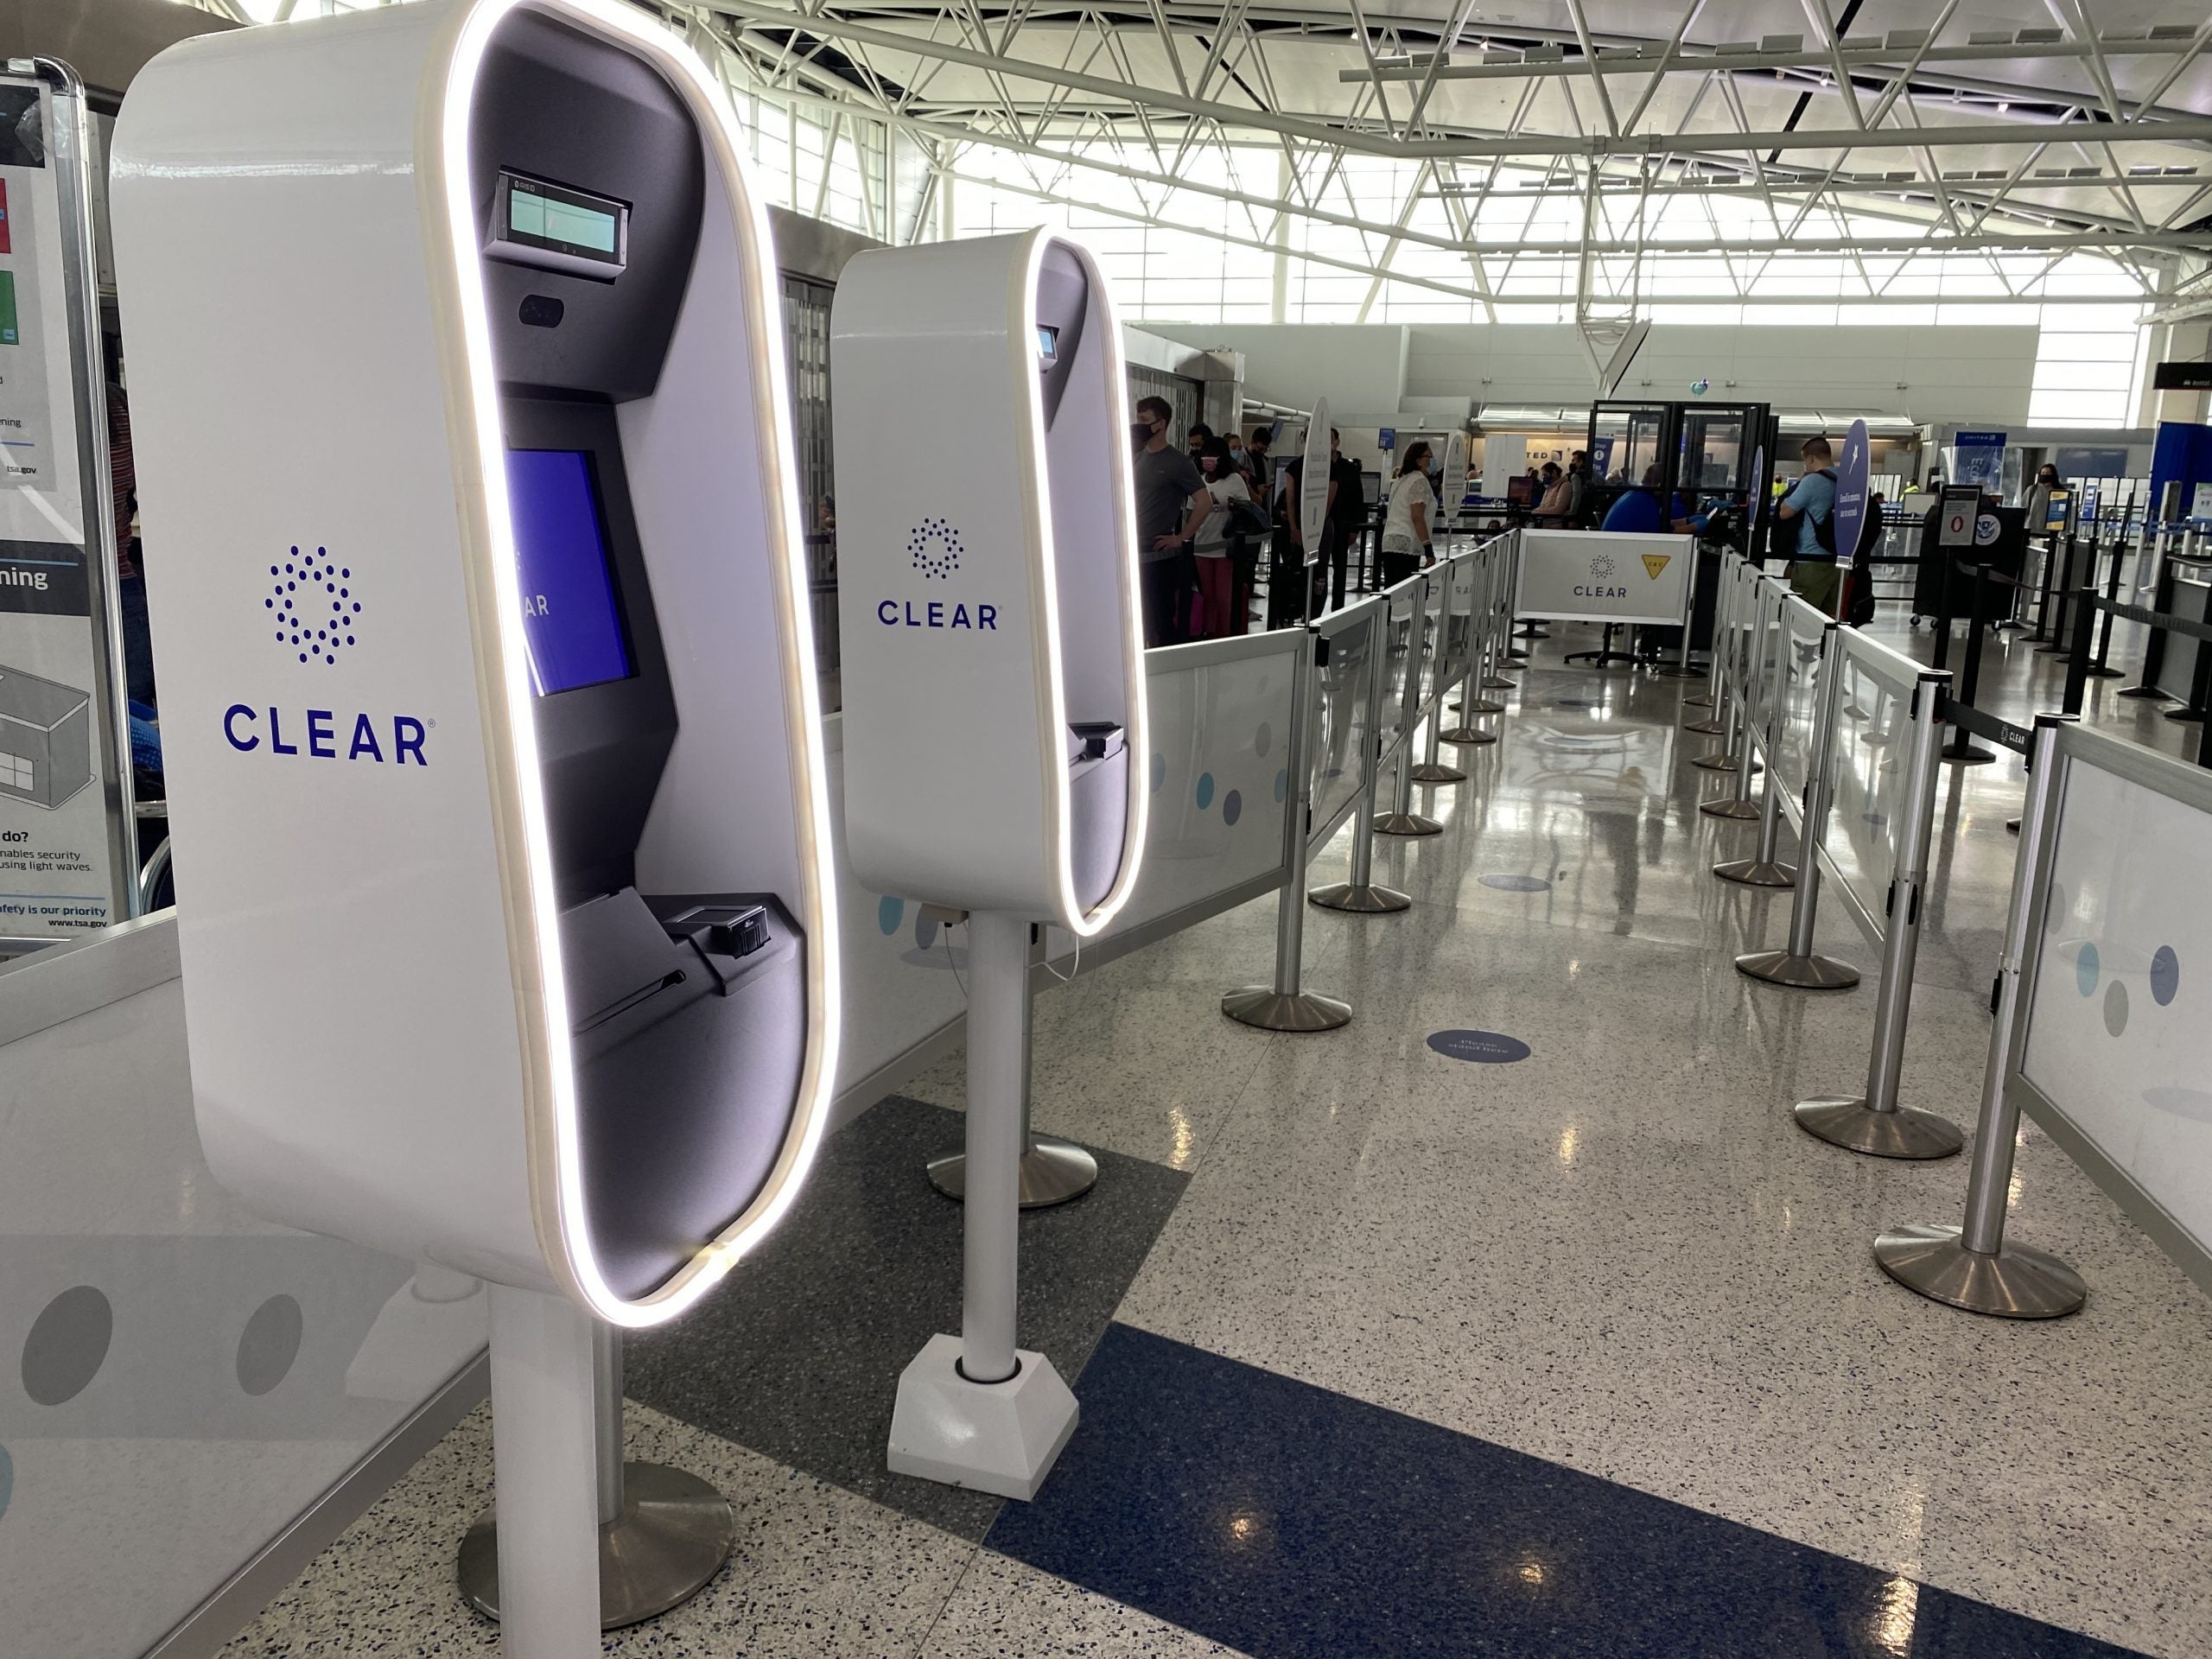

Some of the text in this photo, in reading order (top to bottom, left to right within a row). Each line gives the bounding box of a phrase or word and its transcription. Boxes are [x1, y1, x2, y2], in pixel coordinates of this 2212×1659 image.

[0, 419, 21, 428] ning
[0, 567, 48, 590] ning
[1573, 586, 1626, 598] CLEAR
[878, 600, 997, 630] CLEAR
[2009, 732, 2025, 745] CLEAR
[2, 830, 29, 842] do?
[37, 850, 80, 861] security
[29, 861, 53, 872] light
[56, 863, 92, 872] waves.
[29, 906, 37, 914] is
[63, 906, 106, 917] priority
[48, 919, 107, 929] www.tsa.gov
